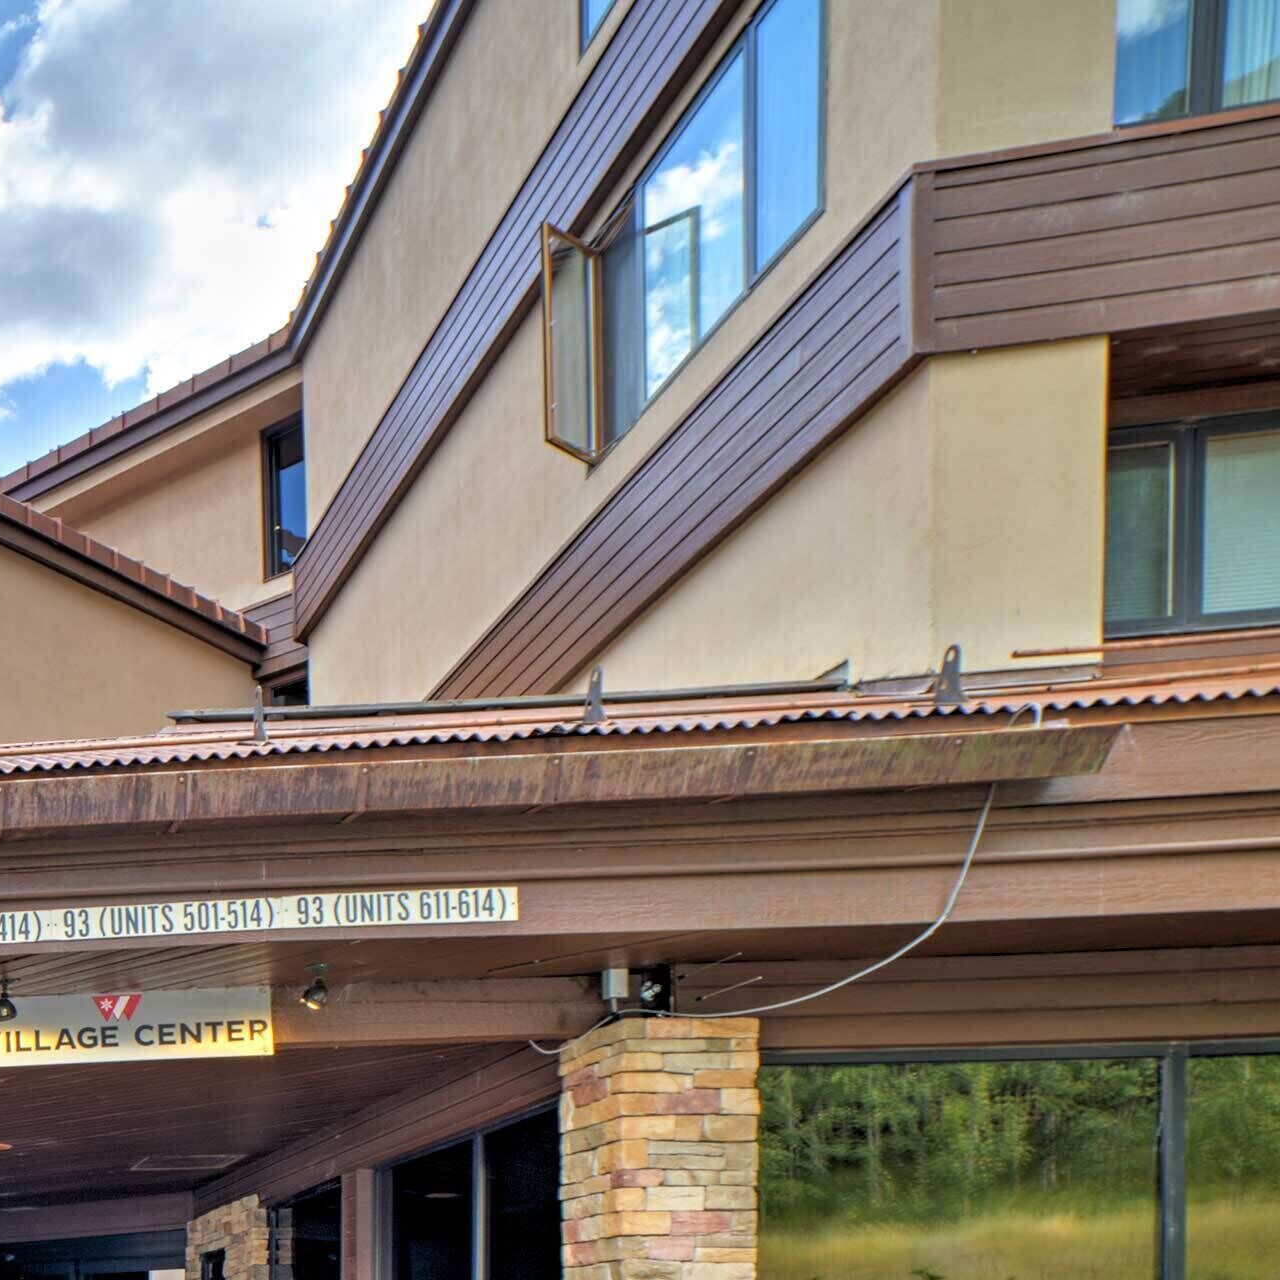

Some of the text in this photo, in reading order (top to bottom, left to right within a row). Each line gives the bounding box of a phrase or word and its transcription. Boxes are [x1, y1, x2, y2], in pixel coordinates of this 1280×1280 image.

[64, 910, 90, 938] 93
[99, 904, 174, 937] (UNITS
[184, 897, 274, 933] 501-514)
[297, 896, 324, 925] 93
[334, 892, 410, 925] (UNITS
[420, 887, 507, 920] 611-614)
[134, 1019, 268, 1046] CENTER
